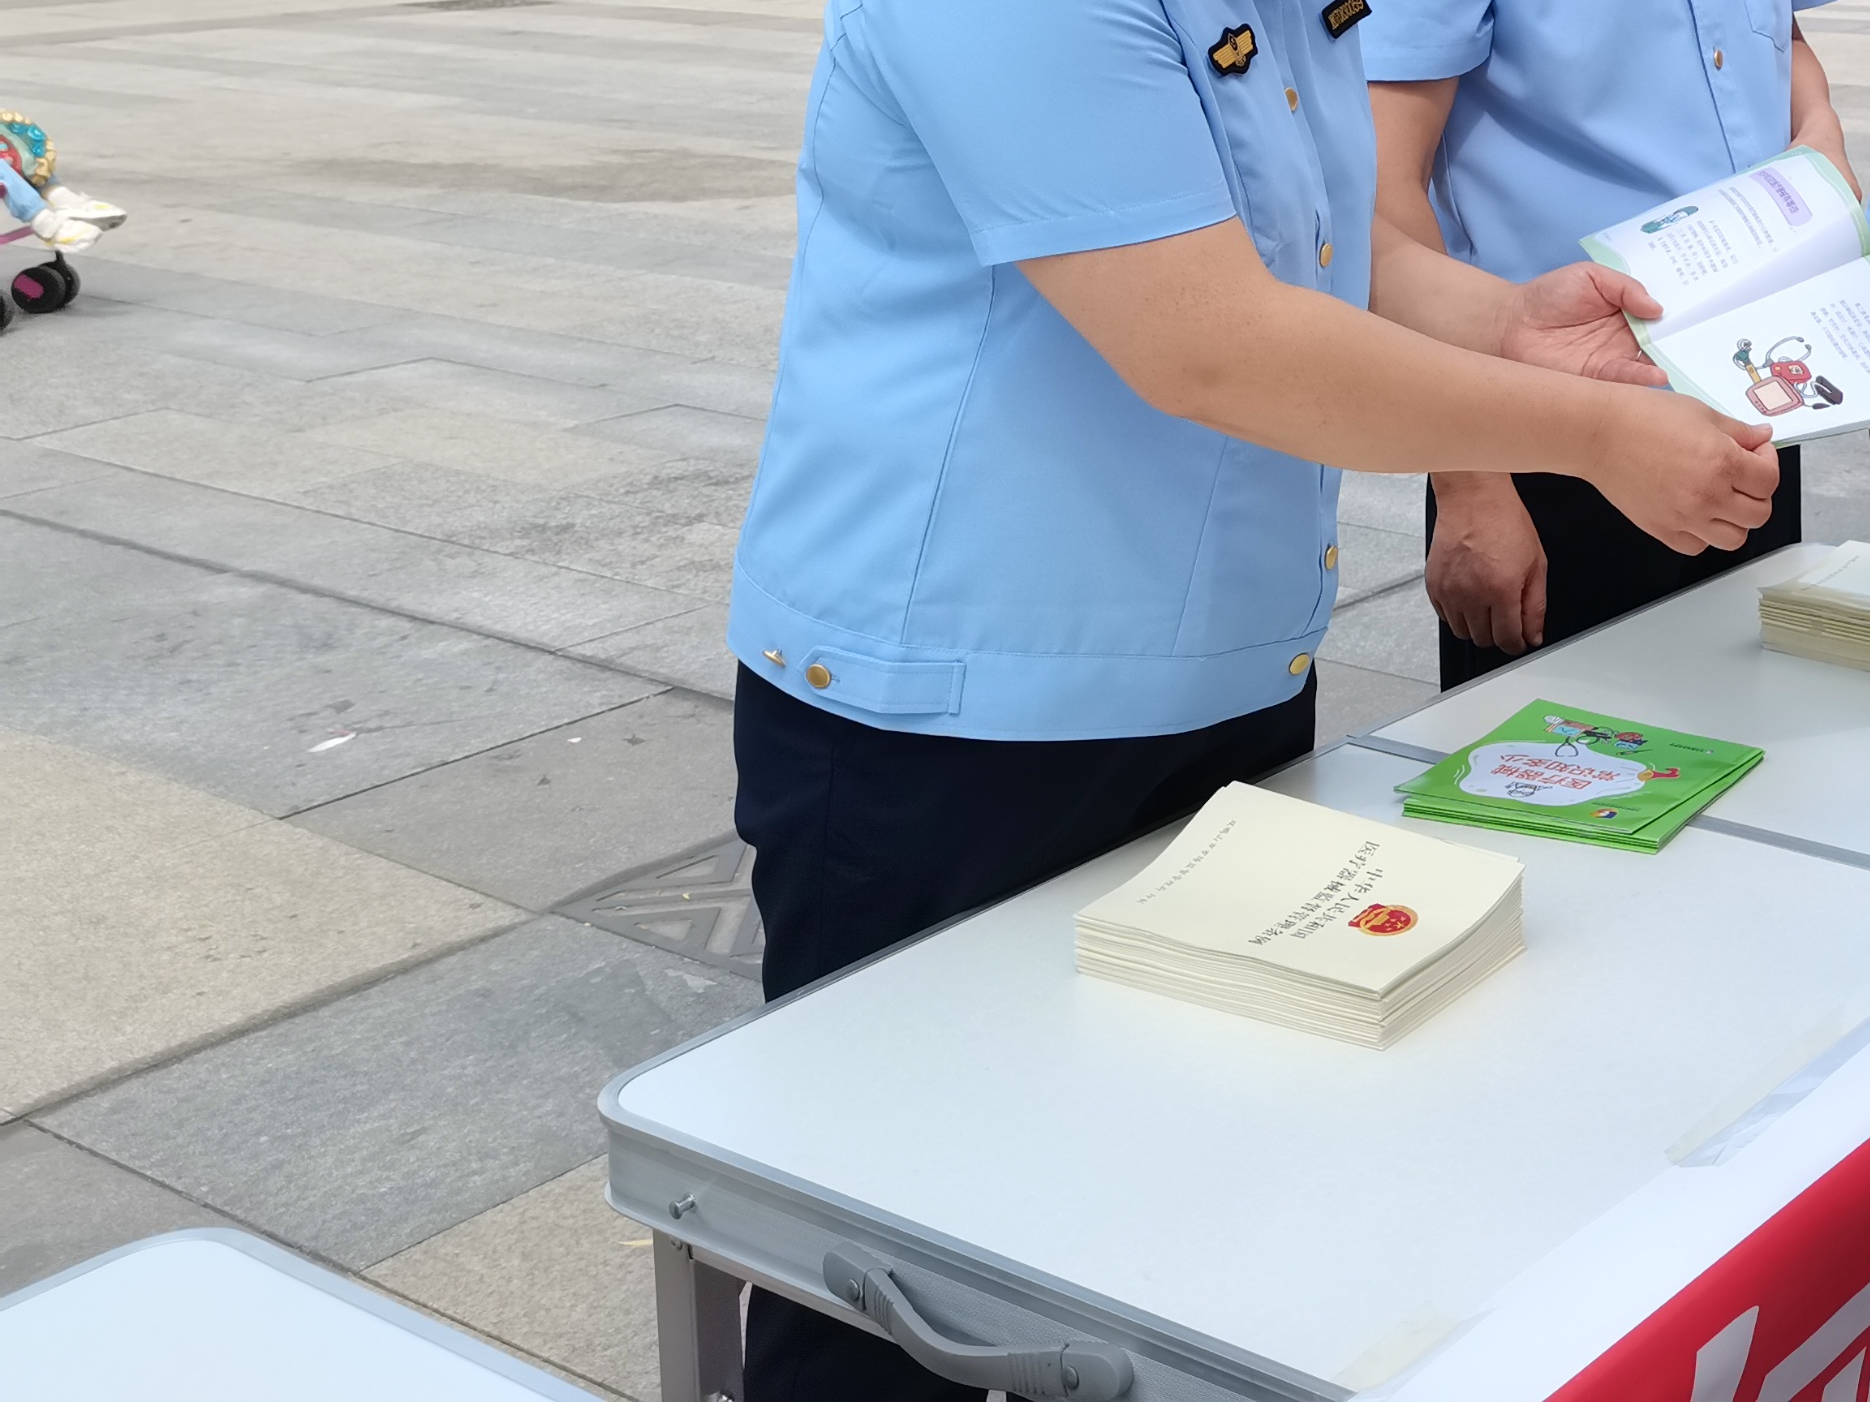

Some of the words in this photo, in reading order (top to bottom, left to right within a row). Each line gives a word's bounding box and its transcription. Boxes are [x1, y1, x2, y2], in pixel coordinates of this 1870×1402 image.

[1490, 764, 1592, 790] 医疗器械
[1500, 754, 1620, 782] 常识知多少
[1248, 841, 1380, 946] 医疗器械监督管理条例
[1289, 868, 1383, 940] 中华人民共和国
